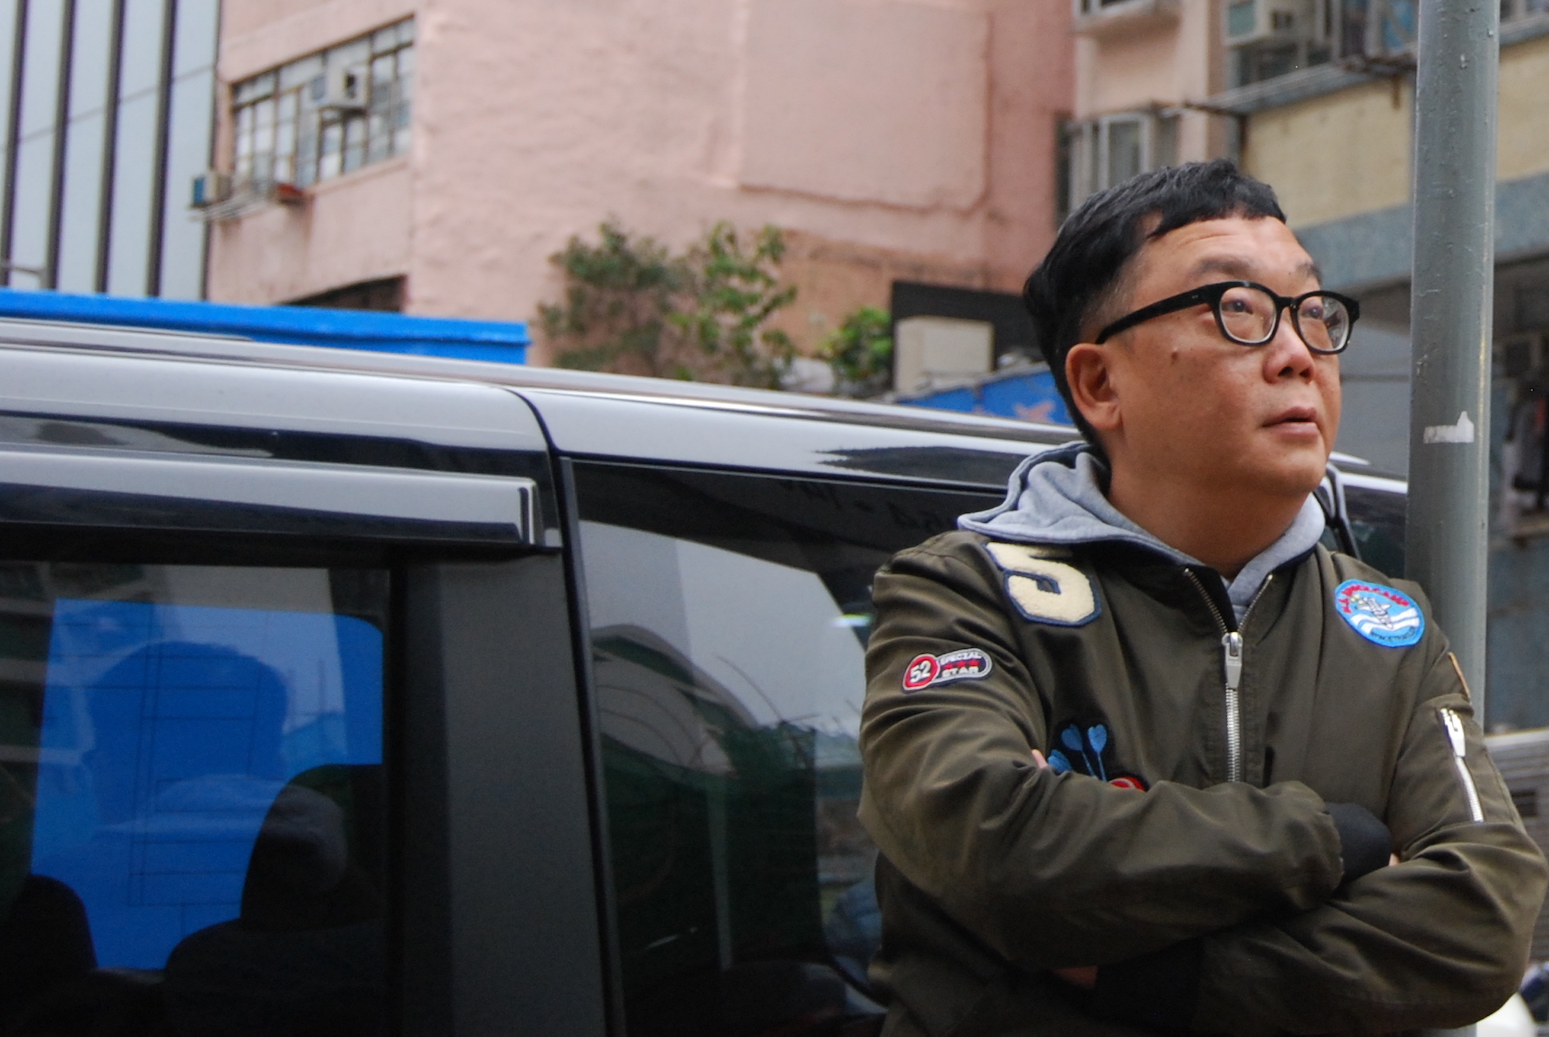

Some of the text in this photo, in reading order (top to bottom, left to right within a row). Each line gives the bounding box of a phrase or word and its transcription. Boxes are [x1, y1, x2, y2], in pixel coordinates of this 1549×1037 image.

[985, 542, 1098, 624] 5
[940, 651, 982, 665] SPECIAL
[909, 660, 932, 683] 52
[942, 666, 979, 678] STAR
